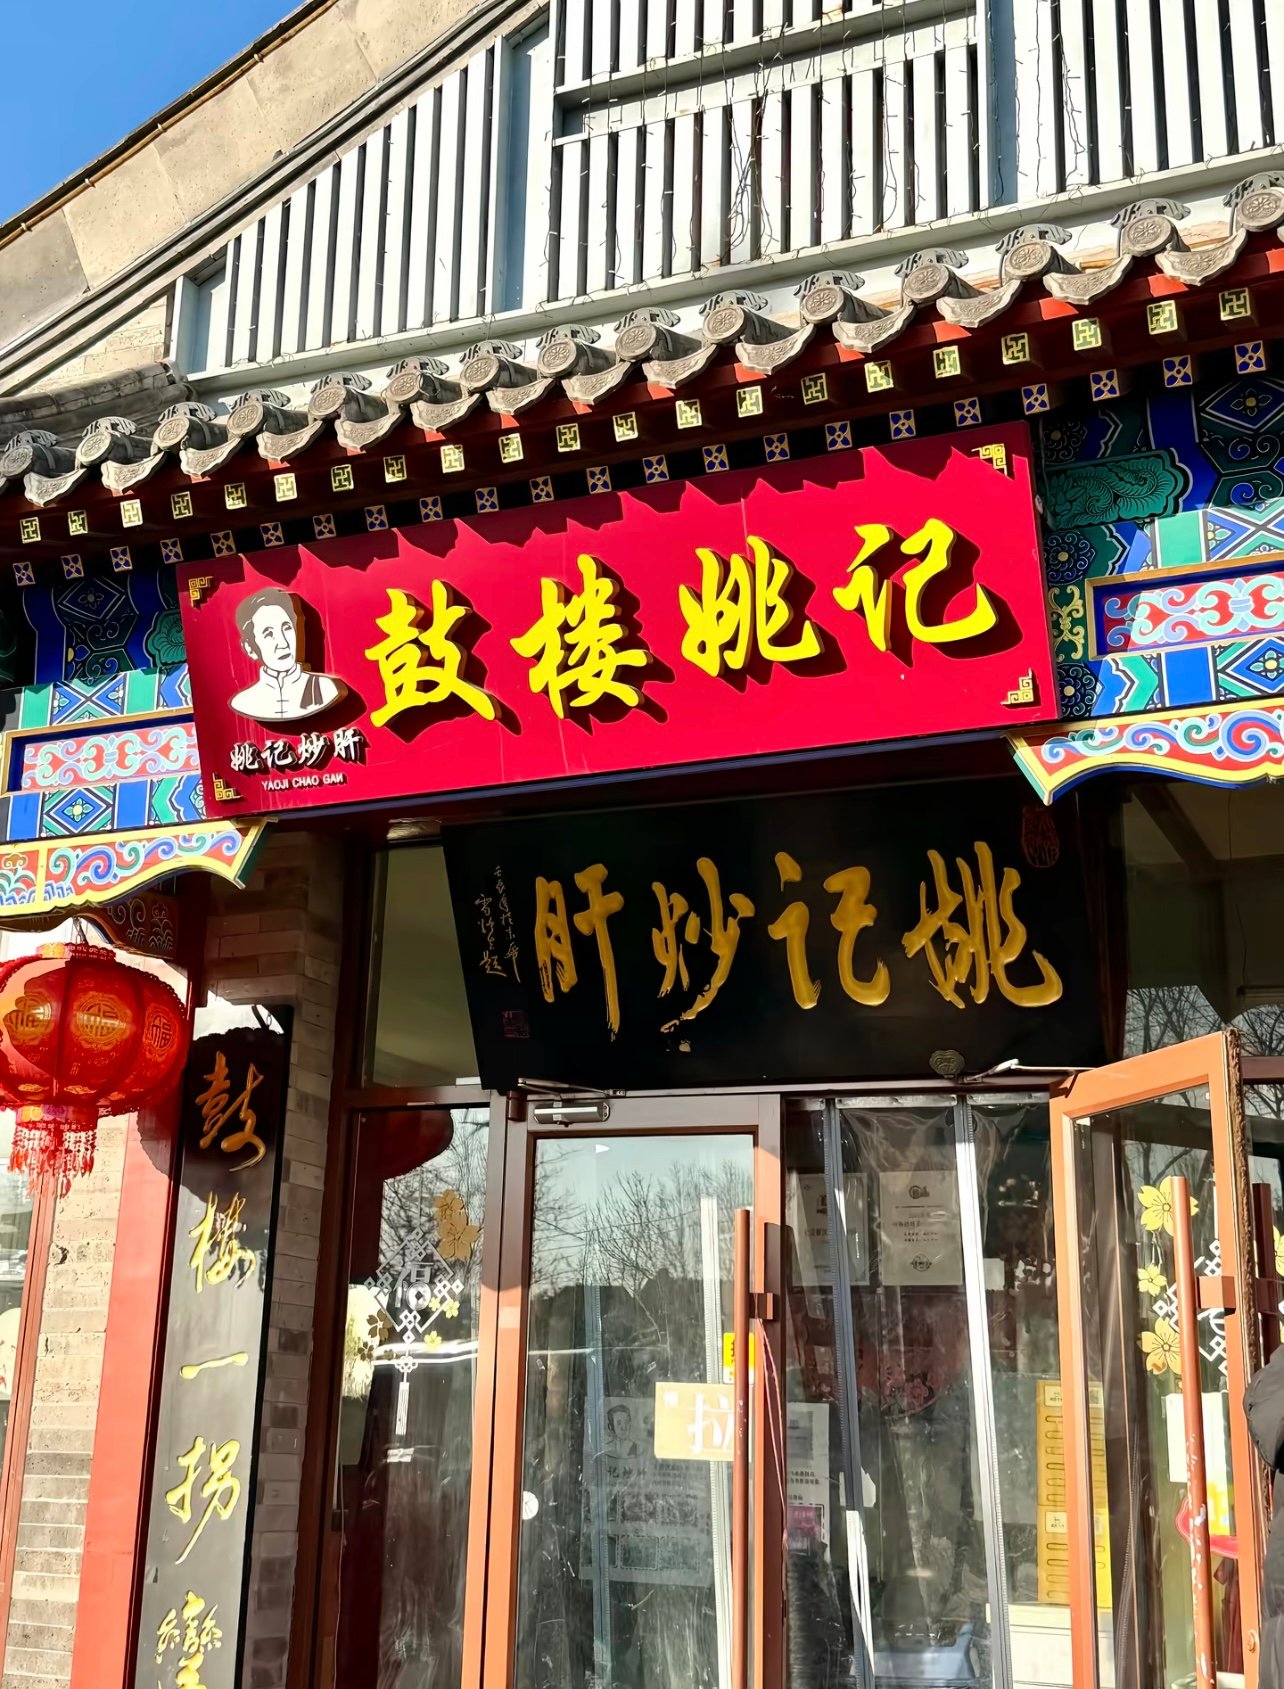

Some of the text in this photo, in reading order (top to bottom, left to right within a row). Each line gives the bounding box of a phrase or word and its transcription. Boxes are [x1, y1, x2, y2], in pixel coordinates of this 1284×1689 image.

[365, 518, 997, 727] 鼓楼姚记
[230, 727, 363, 772] 姚记炒肝
[261, 778, 289, 791] YAOJI
[292, 775, 319, 787] CHAO
